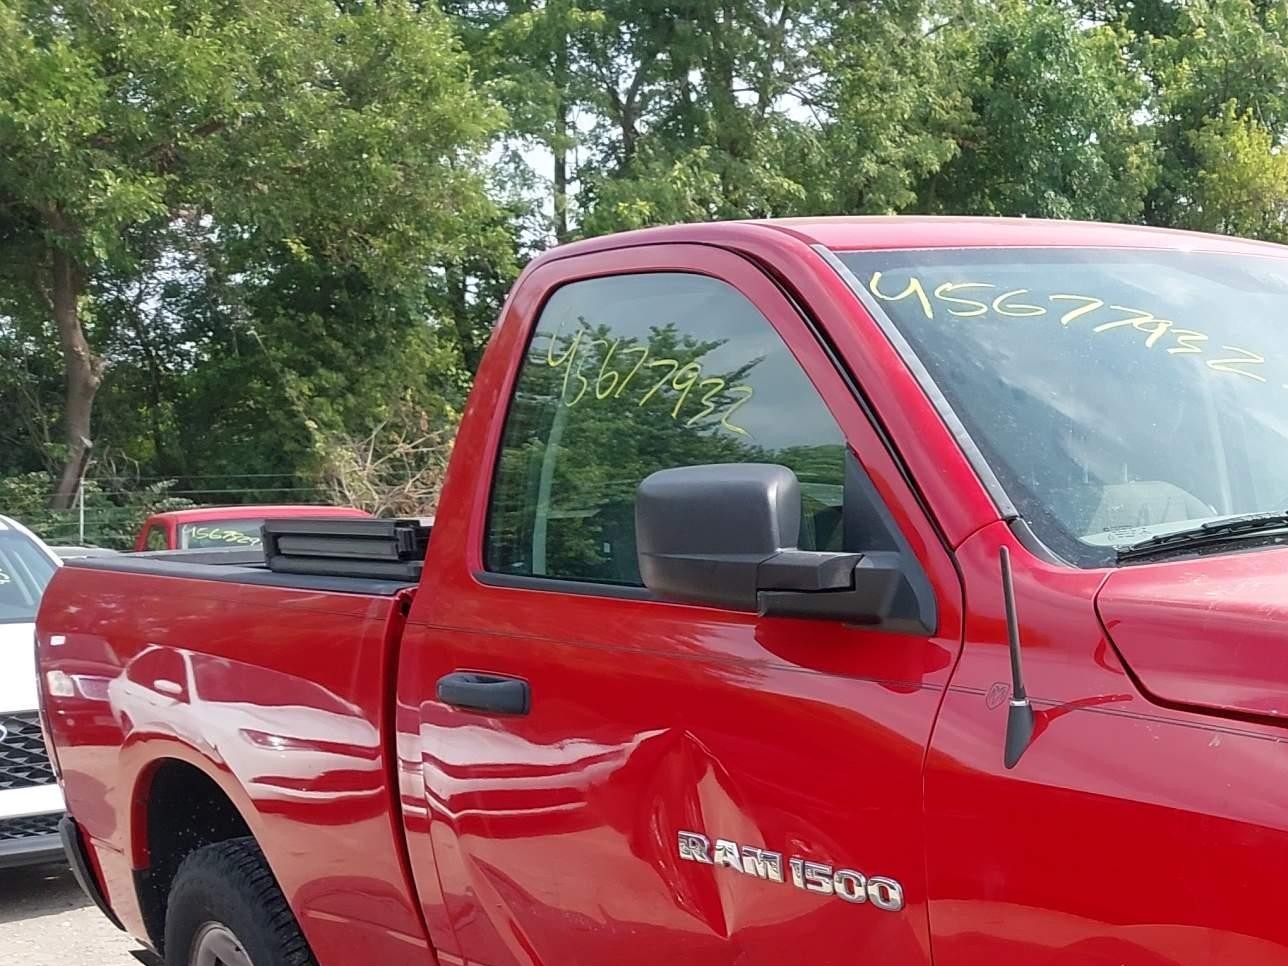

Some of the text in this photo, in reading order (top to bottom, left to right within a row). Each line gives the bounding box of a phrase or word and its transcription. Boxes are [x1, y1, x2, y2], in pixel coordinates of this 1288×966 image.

[870, 271, 1268, 383] 45677932
[546, 329, 754, 435] 45677932
[677, 831, 905, 912] RAM 1500
